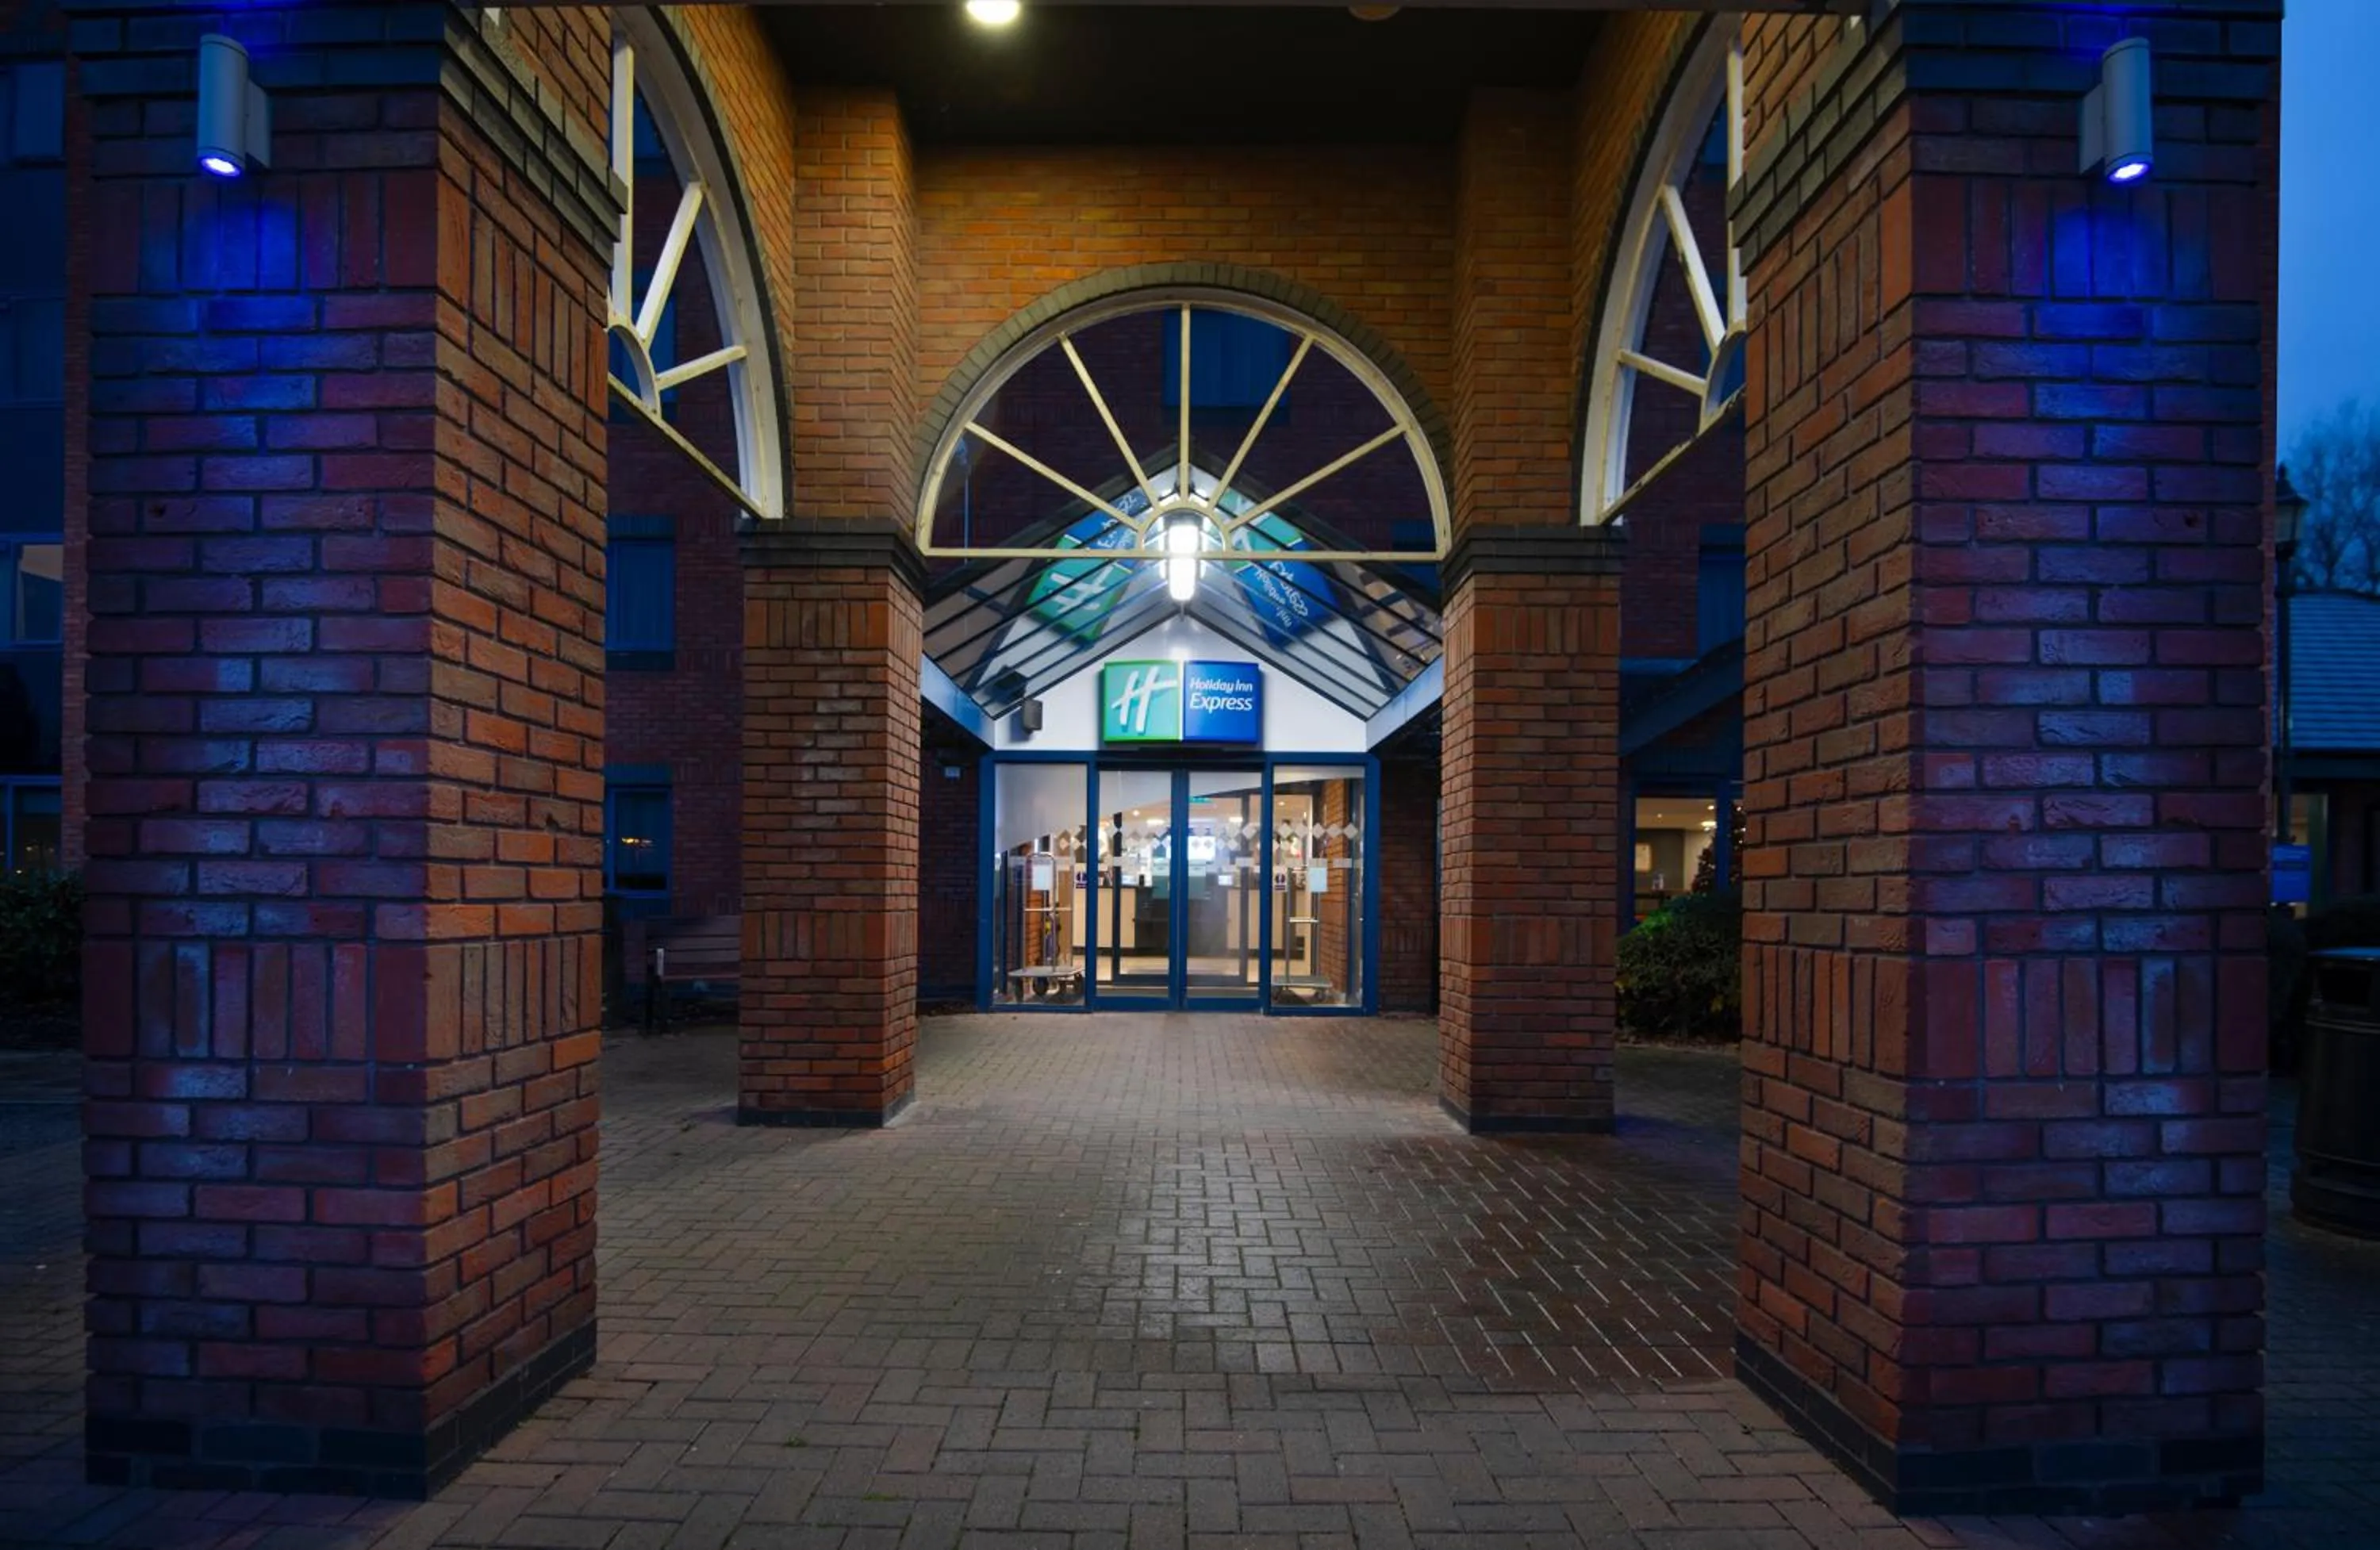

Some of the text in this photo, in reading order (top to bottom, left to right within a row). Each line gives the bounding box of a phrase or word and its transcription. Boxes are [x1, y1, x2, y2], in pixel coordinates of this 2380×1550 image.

[1189, 677, 1253, 694] Holiday Inn
[1111, 666, 1177, 733] H
[1189, 693, 1253, 714] Express
